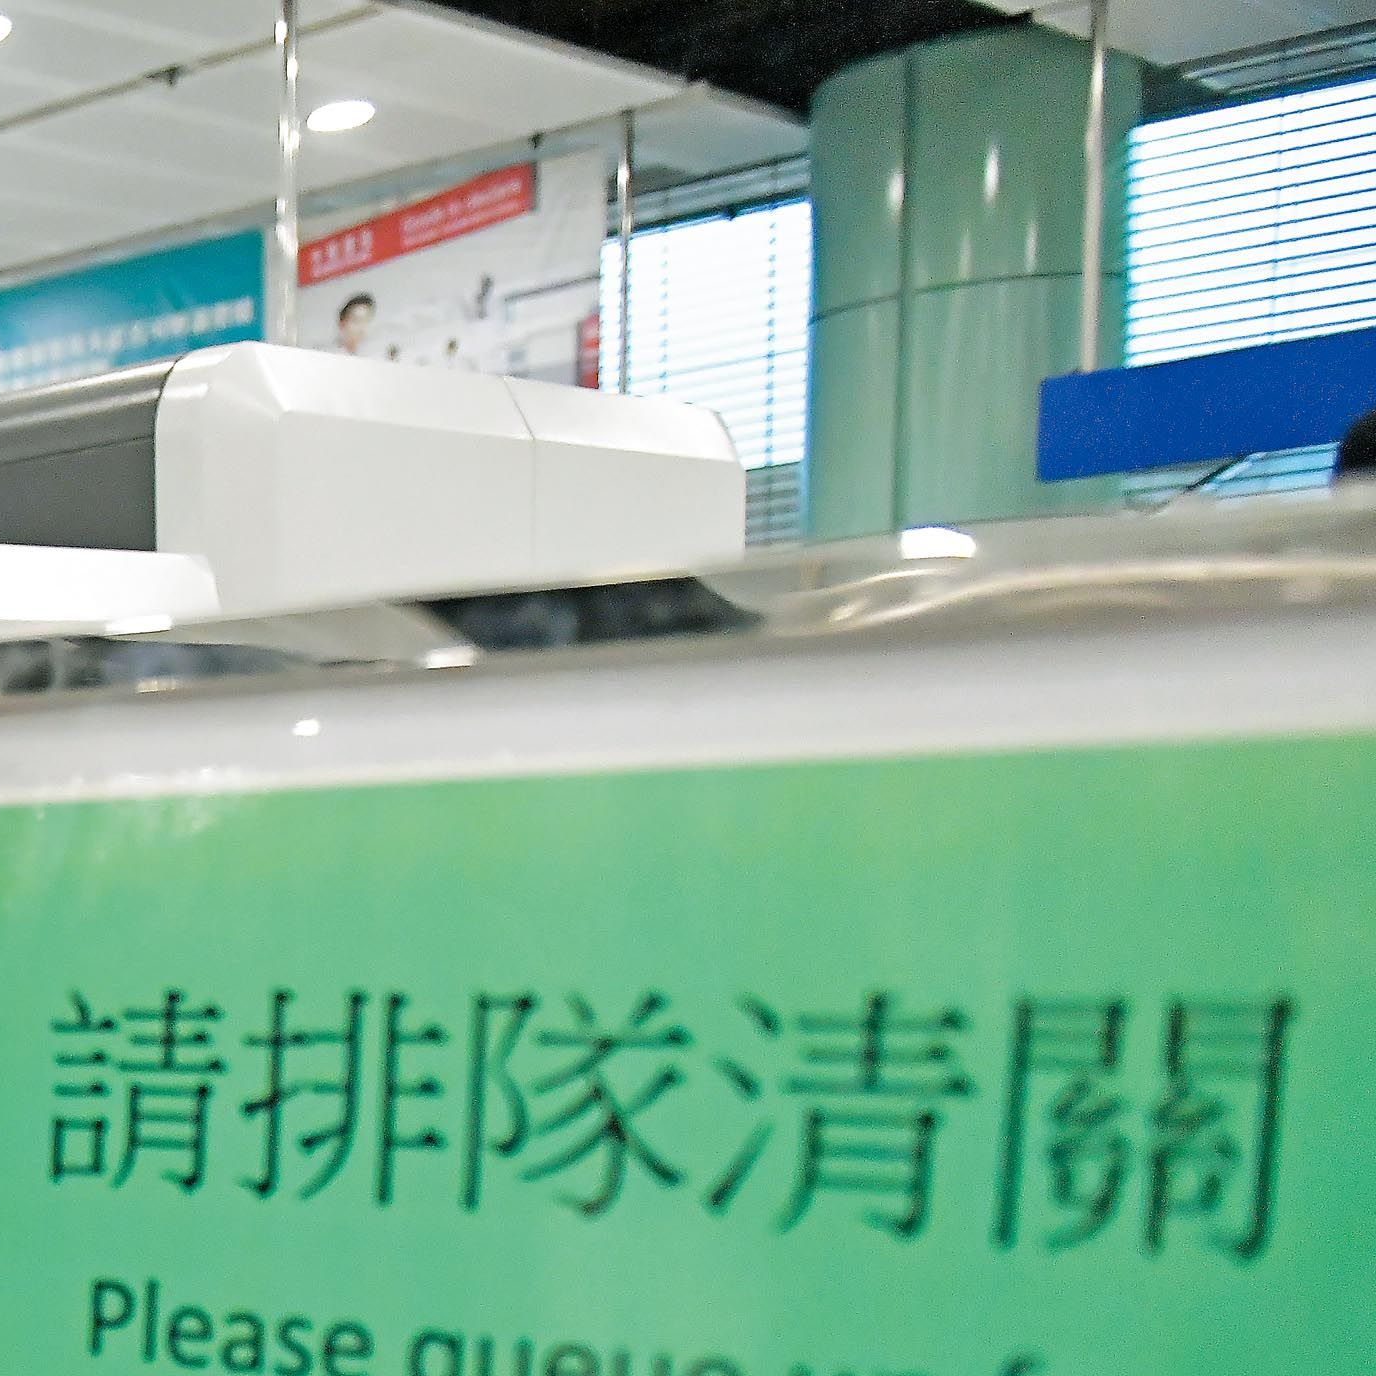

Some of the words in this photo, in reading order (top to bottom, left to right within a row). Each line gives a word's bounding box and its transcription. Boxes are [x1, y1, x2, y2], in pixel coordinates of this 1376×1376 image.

[46, 985, 1300, 1269] 請排隊清關
